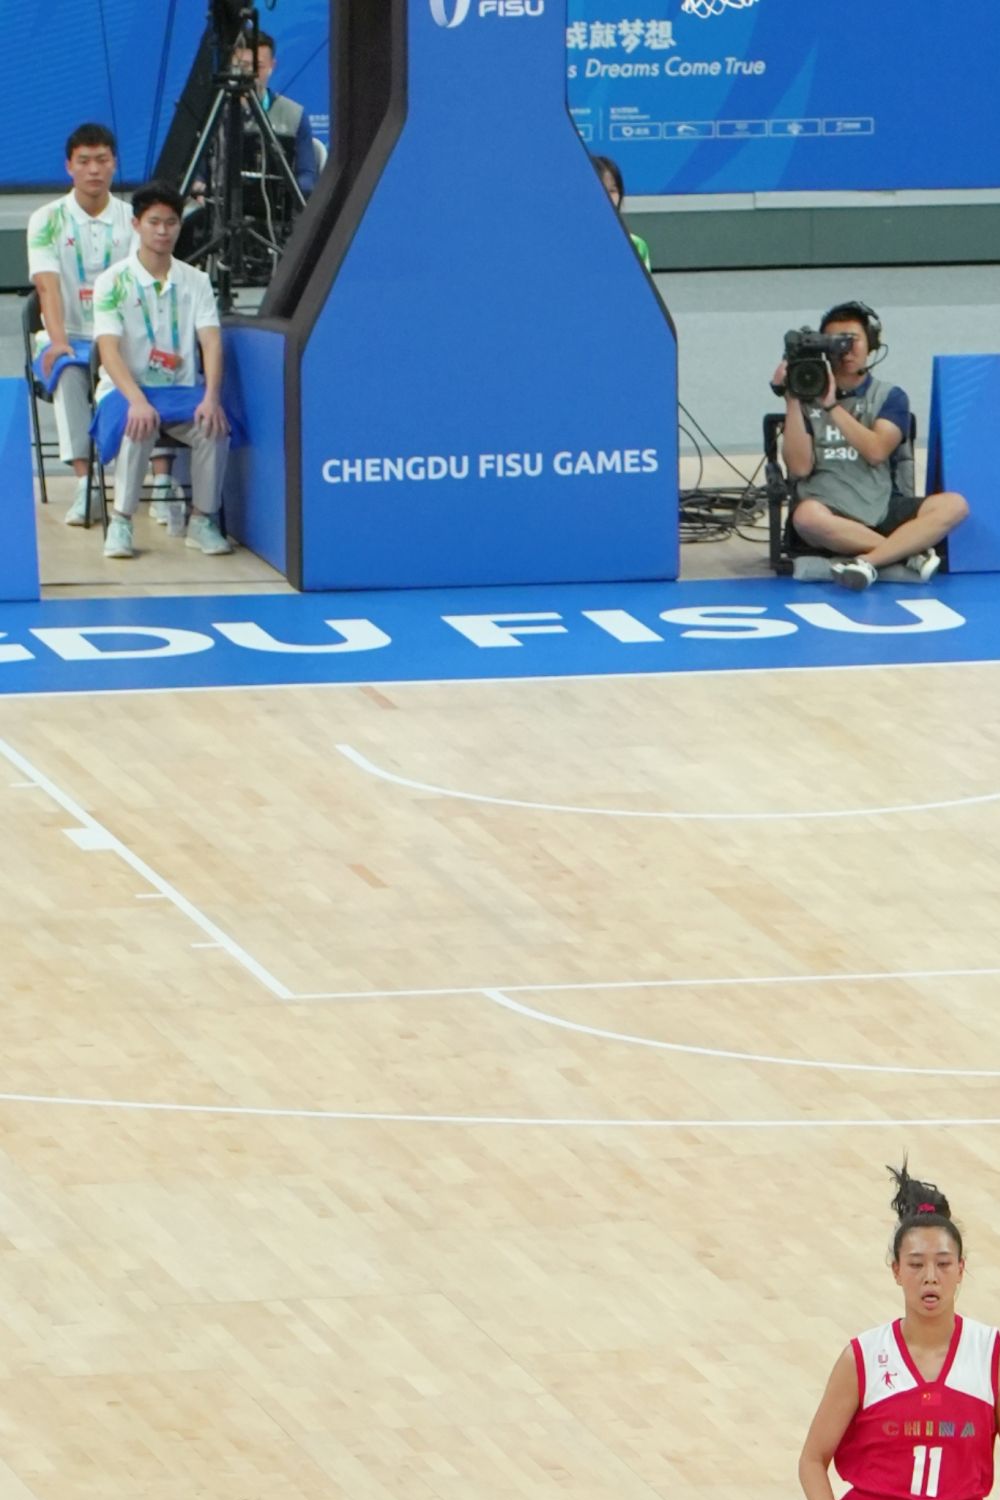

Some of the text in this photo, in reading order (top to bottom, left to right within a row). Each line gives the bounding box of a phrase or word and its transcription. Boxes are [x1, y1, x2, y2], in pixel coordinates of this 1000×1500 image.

[478, 0, 544, 17] FISU
[585, 58, 660, 78] Dreams
[664, 56, 721, 76] Come
[724, 57, 766, 75] True
[321, 449, 659, 483] CHENGDU FISU GAMES
[441, 598, 966, 649] FISU
[882, 1420, 976, 1438] CHINA
[910, 1445, 943, 1498] 11
